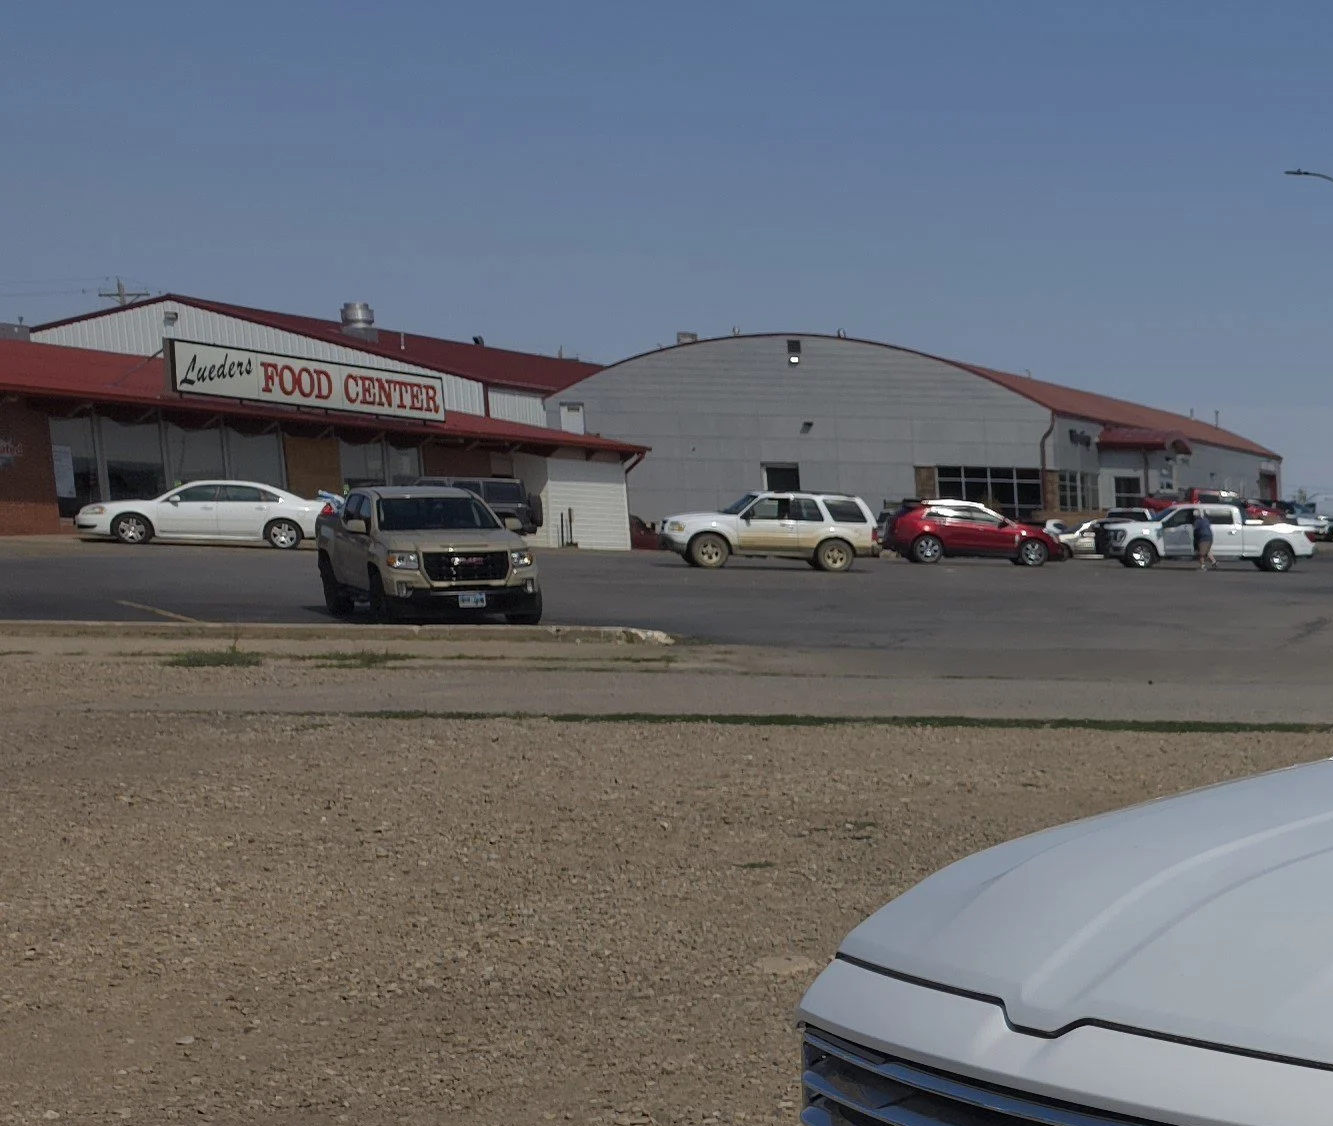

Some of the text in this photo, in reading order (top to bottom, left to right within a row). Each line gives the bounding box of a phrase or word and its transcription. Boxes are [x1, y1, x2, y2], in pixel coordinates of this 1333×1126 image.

[179, 352, 441, 415] Lueders FOOD CENTER
